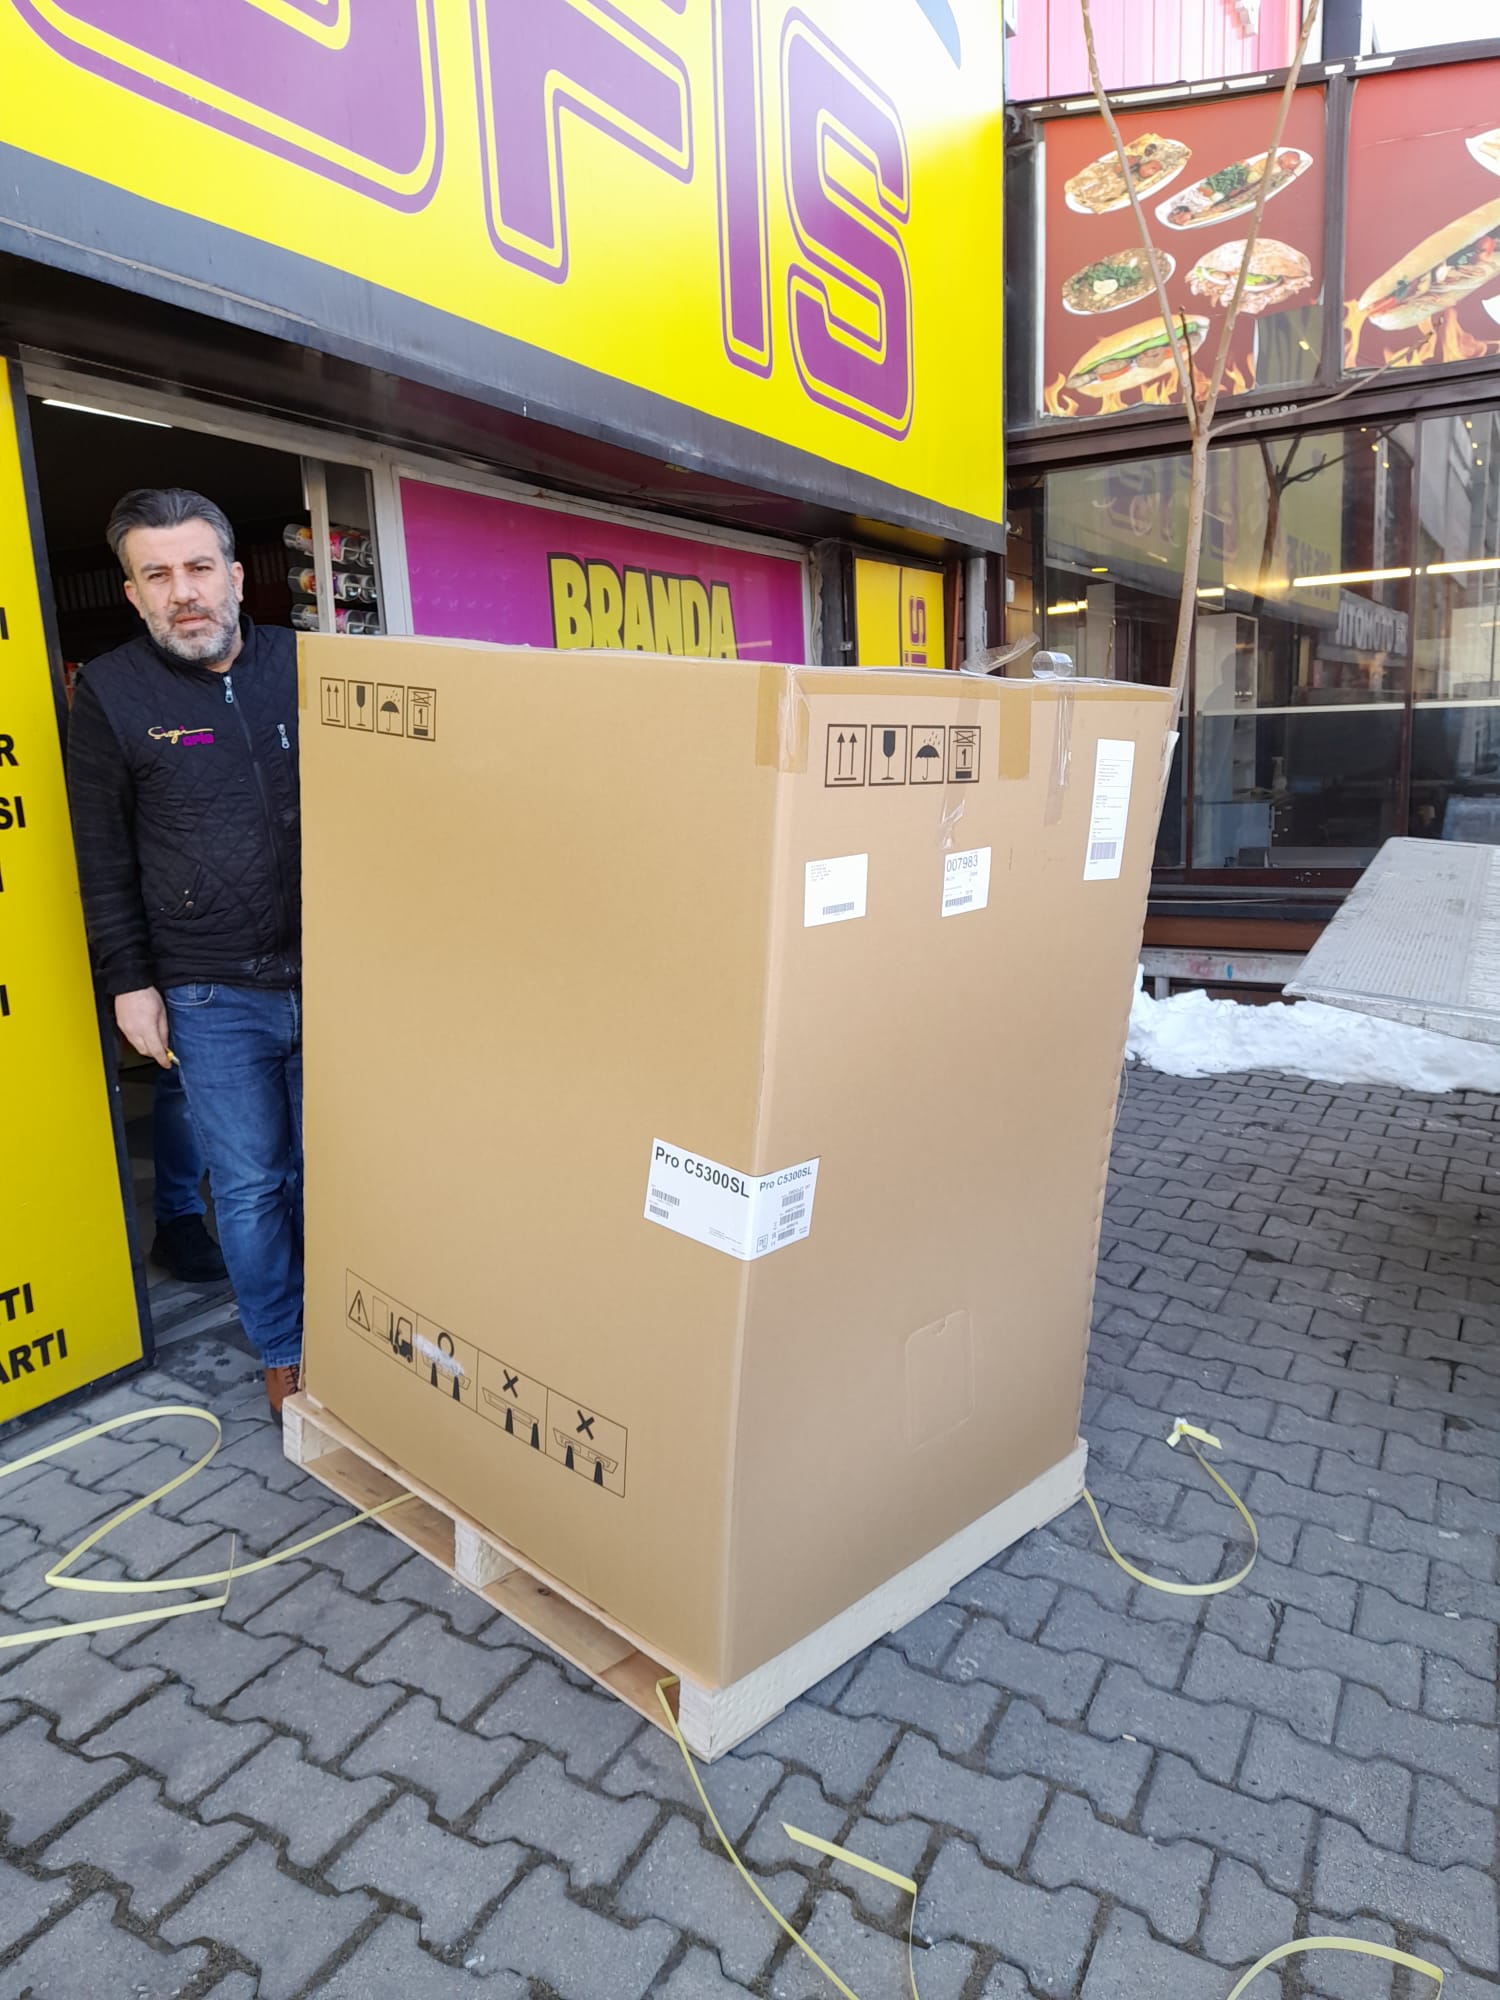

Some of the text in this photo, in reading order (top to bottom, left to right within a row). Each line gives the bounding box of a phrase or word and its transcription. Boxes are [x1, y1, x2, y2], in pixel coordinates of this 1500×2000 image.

[547, 552, 739, 659] BRANDA
[946, 854, 979, 873] 007983
[655, 1146, 680, 1169] Pro
[684, 1158, 750, 1198] C5300SL
[759, 1180, 775, 1192] Pro
[776, 1166, 812, 1186] C5300SL
